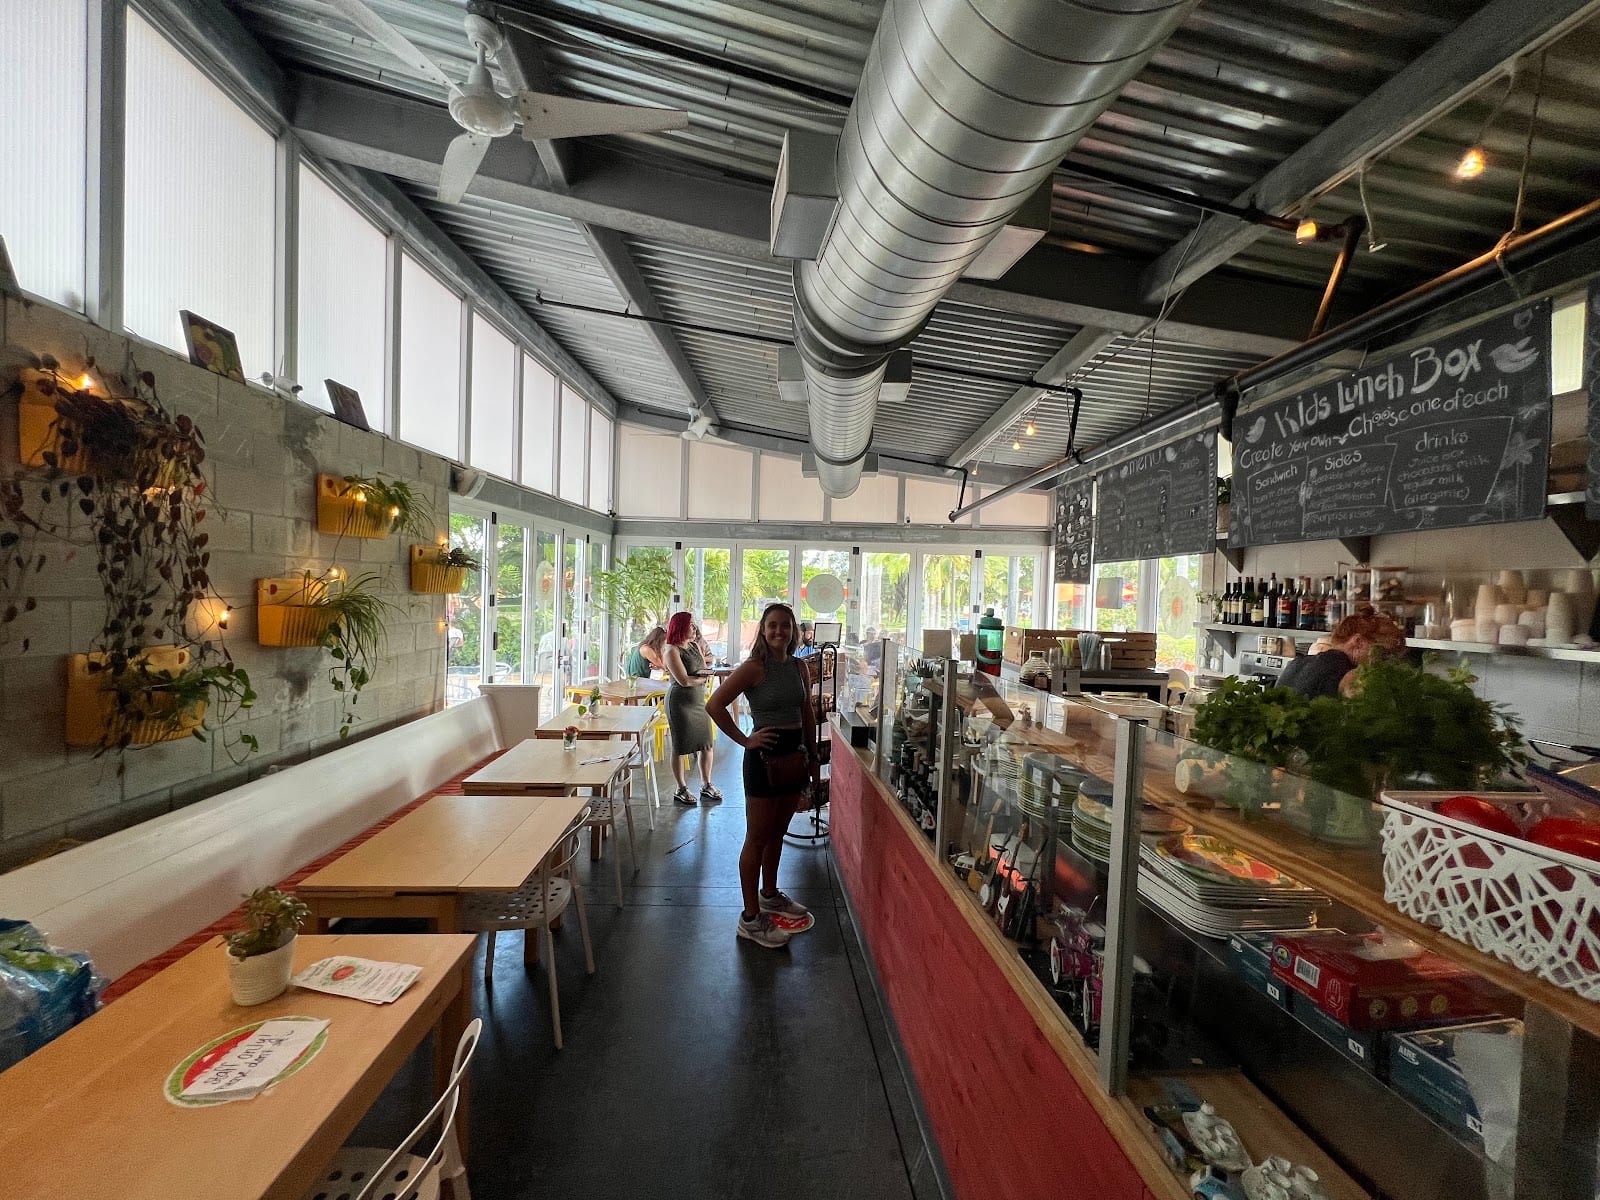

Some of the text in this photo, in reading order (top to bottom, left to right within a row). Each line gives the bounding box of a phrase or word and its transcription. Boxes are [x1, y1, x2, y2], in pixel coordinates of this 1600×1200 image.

[1275, 338, 1485, 438] Kids Lunch Box
[1240, 441, 1283, 469] Create
[1410, 397, 1441, 416] one
[1463, 379, 1509, 408] each
[1415, 428, 1469, 453] drinks
[1438, 473, 1465, 485] milk
